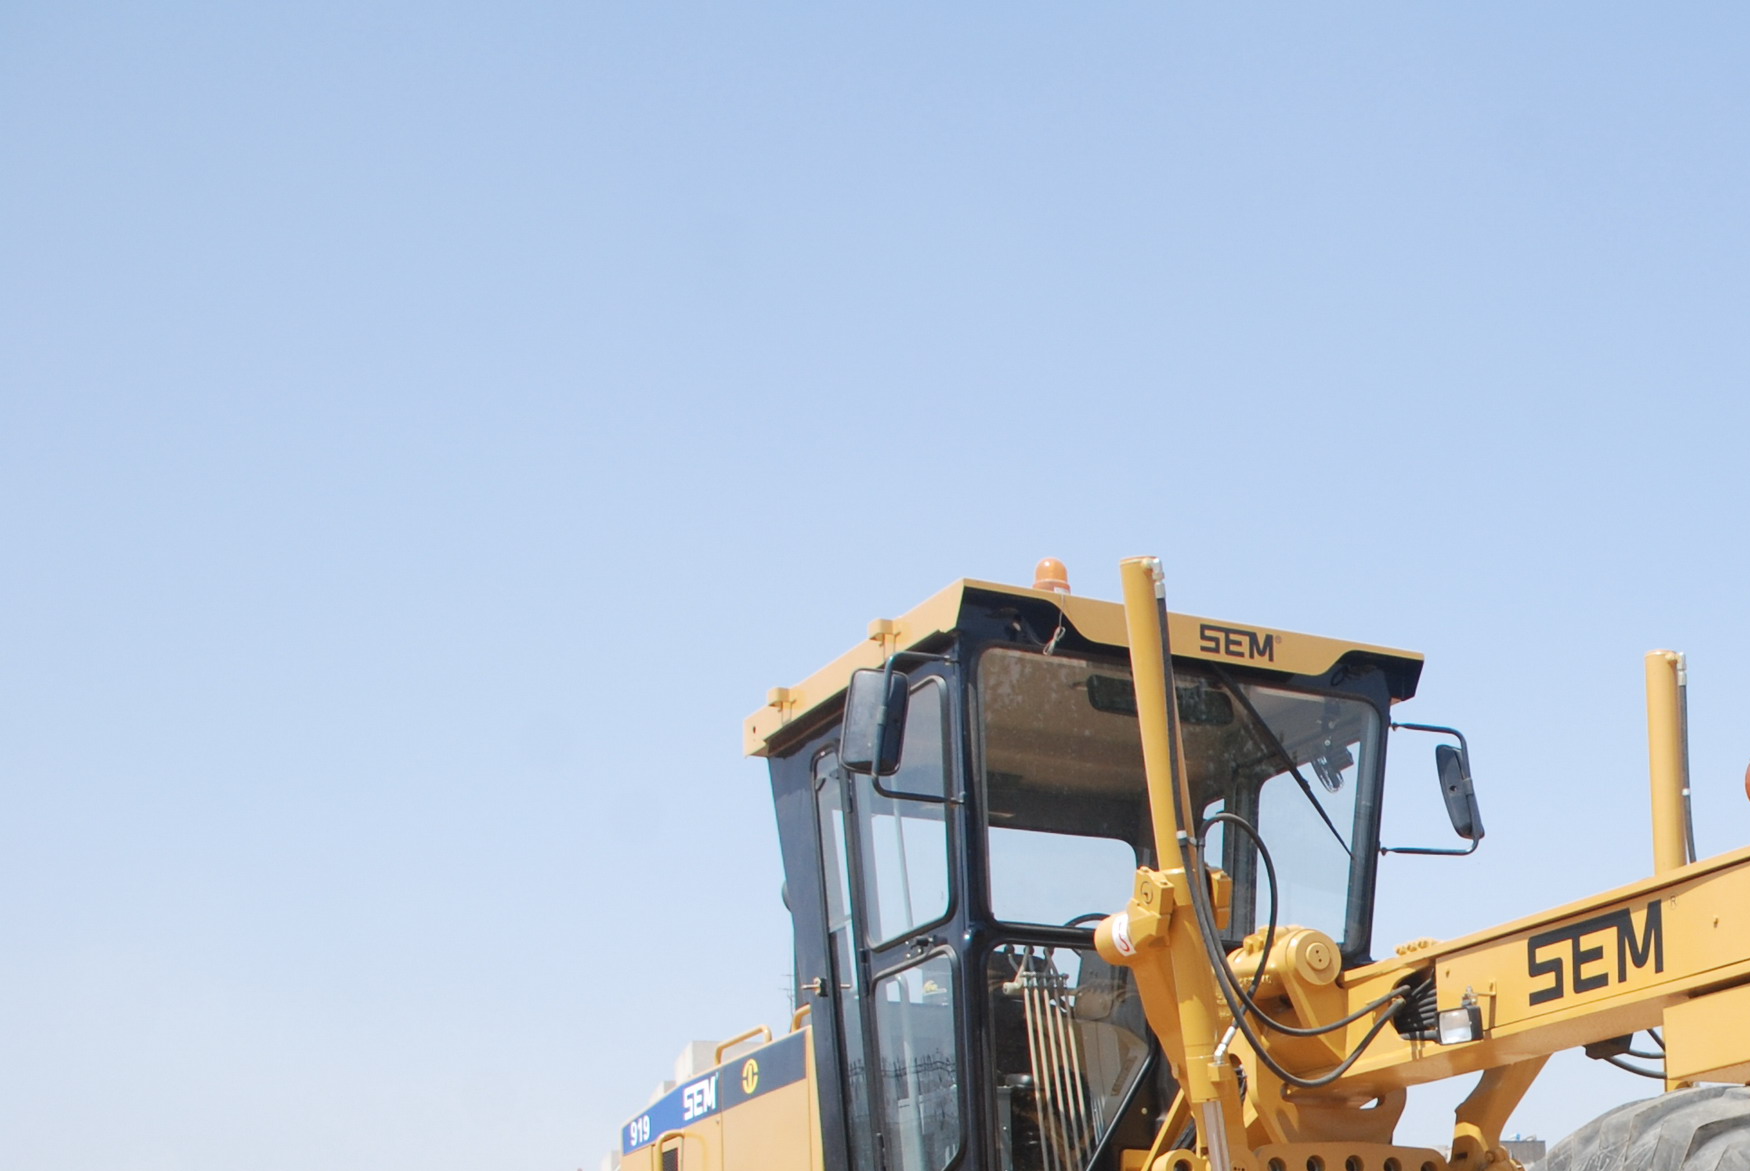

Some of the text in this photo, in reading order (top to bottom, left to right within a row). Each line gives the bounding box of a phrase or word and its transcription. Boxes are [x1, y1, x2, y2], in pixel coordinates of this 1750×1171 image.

[1199, 623, 1274, 662] SEM
[1527, 898, 1664, 1007] SEM
[682, 1075, 717, 1121] SEM
[630, 1115, 651, 1146] 919
